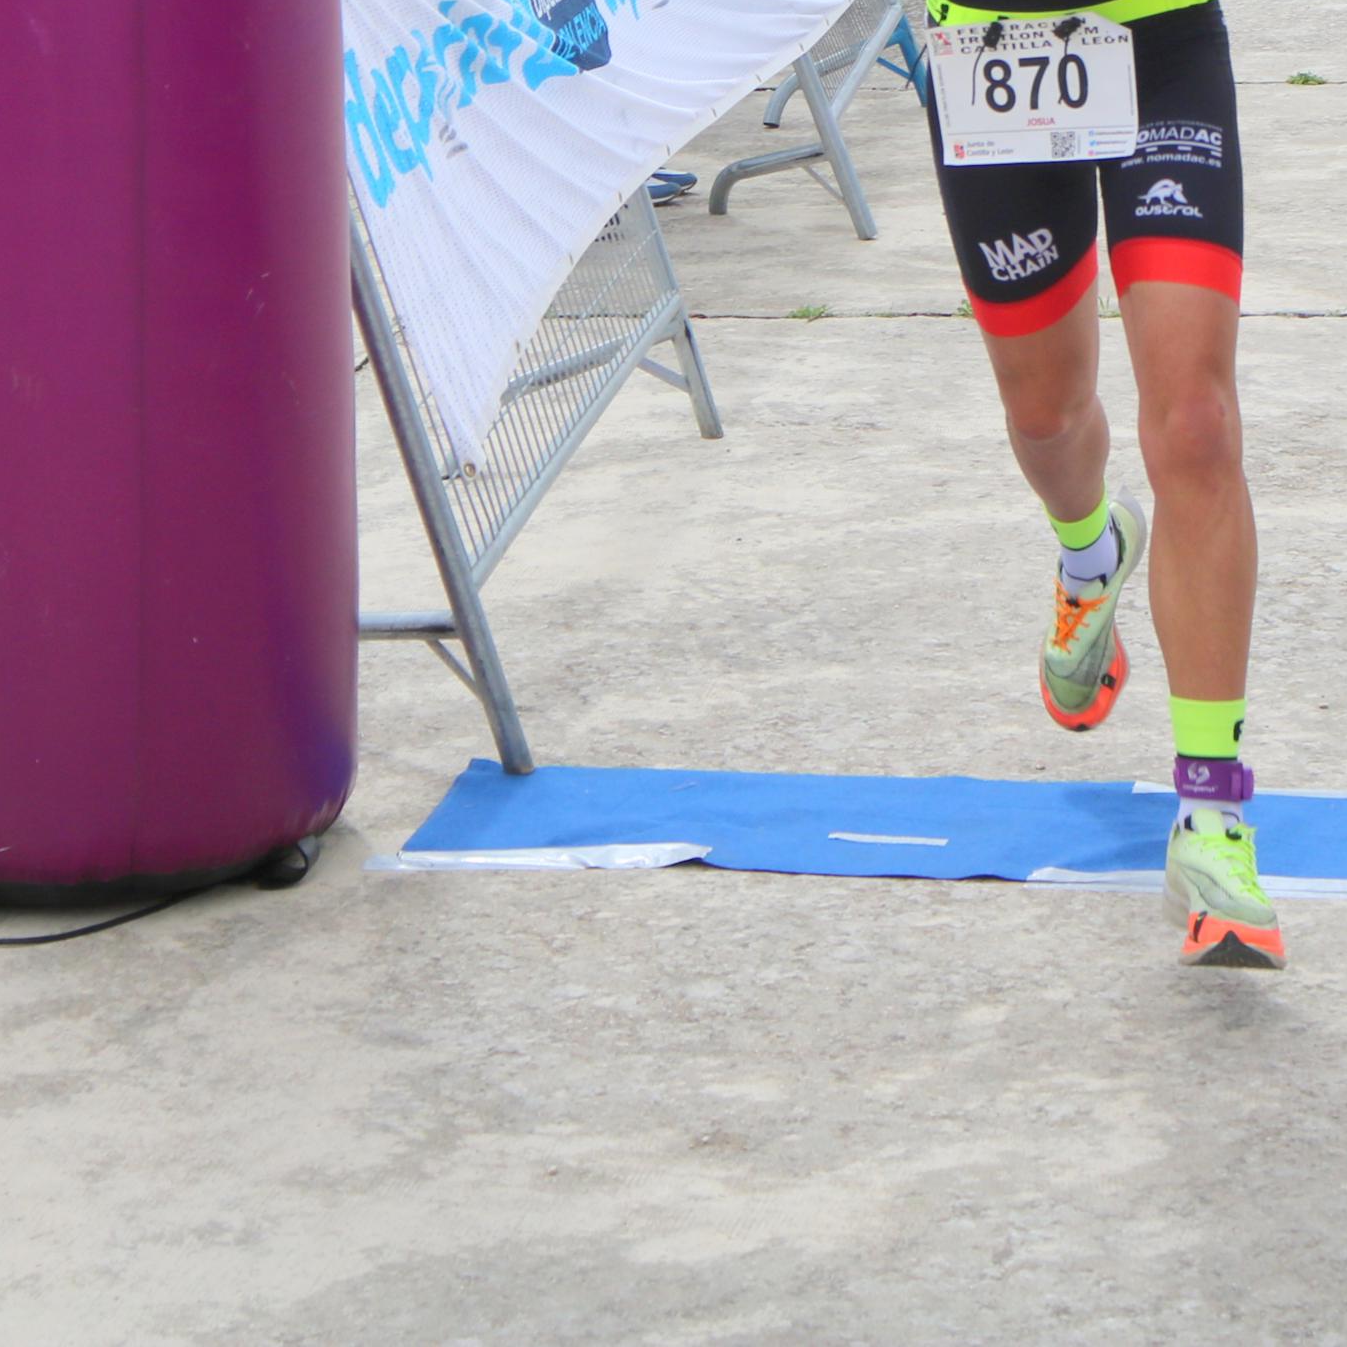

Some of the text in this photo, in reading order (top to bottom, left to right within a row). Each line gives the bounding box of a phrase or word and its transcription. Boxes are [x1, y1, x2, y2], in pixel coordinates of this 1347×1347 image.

[983, 53, 1089, 113] 870
[1027, 117, 1055, 127] JOSUA
[1137, 127, 1222, 146] OMADAC
[1147, 153, 1222, 169] nomadac.es
[978, 228, 1053, 269] MAD
